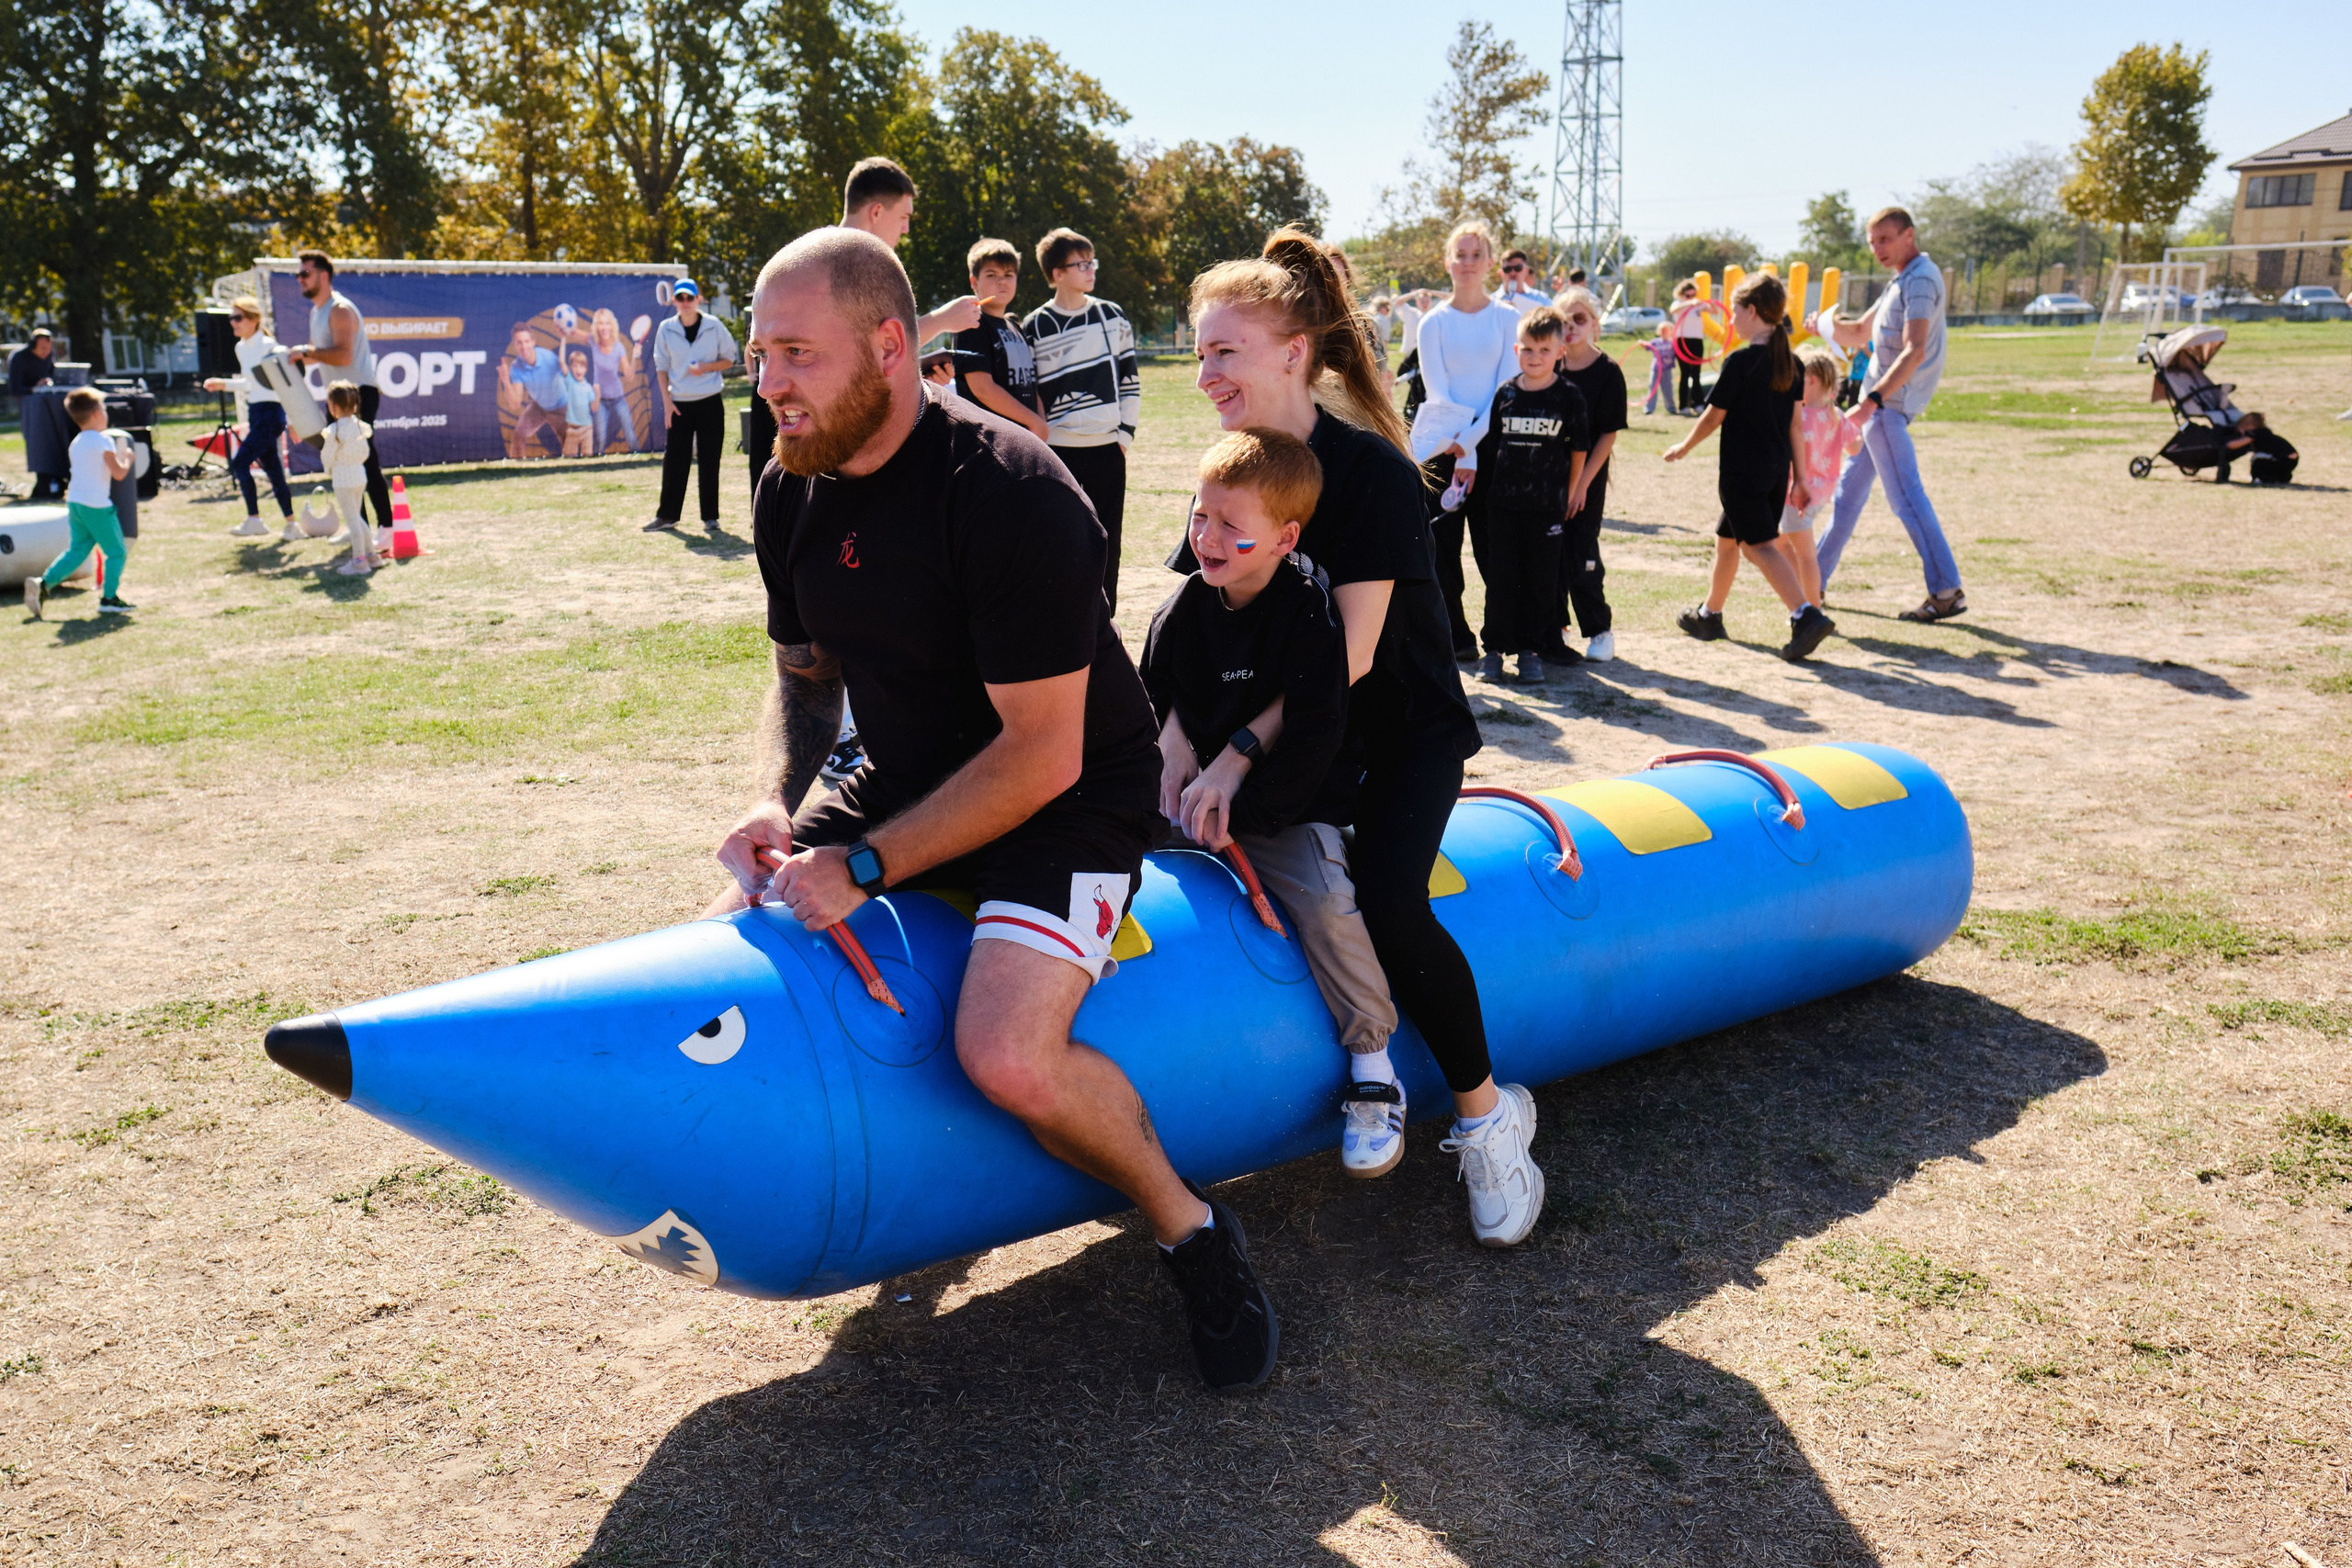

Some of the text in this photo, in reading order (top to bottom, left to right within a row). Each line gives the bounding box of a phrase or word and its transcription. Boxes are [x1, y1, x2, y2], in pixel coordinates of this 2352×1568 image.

[380, 321, 448, 334] ВЫБИРАЕТ
[304, 350, 487, 401] ОРТ
[420, 414, 447, 427] 2025
